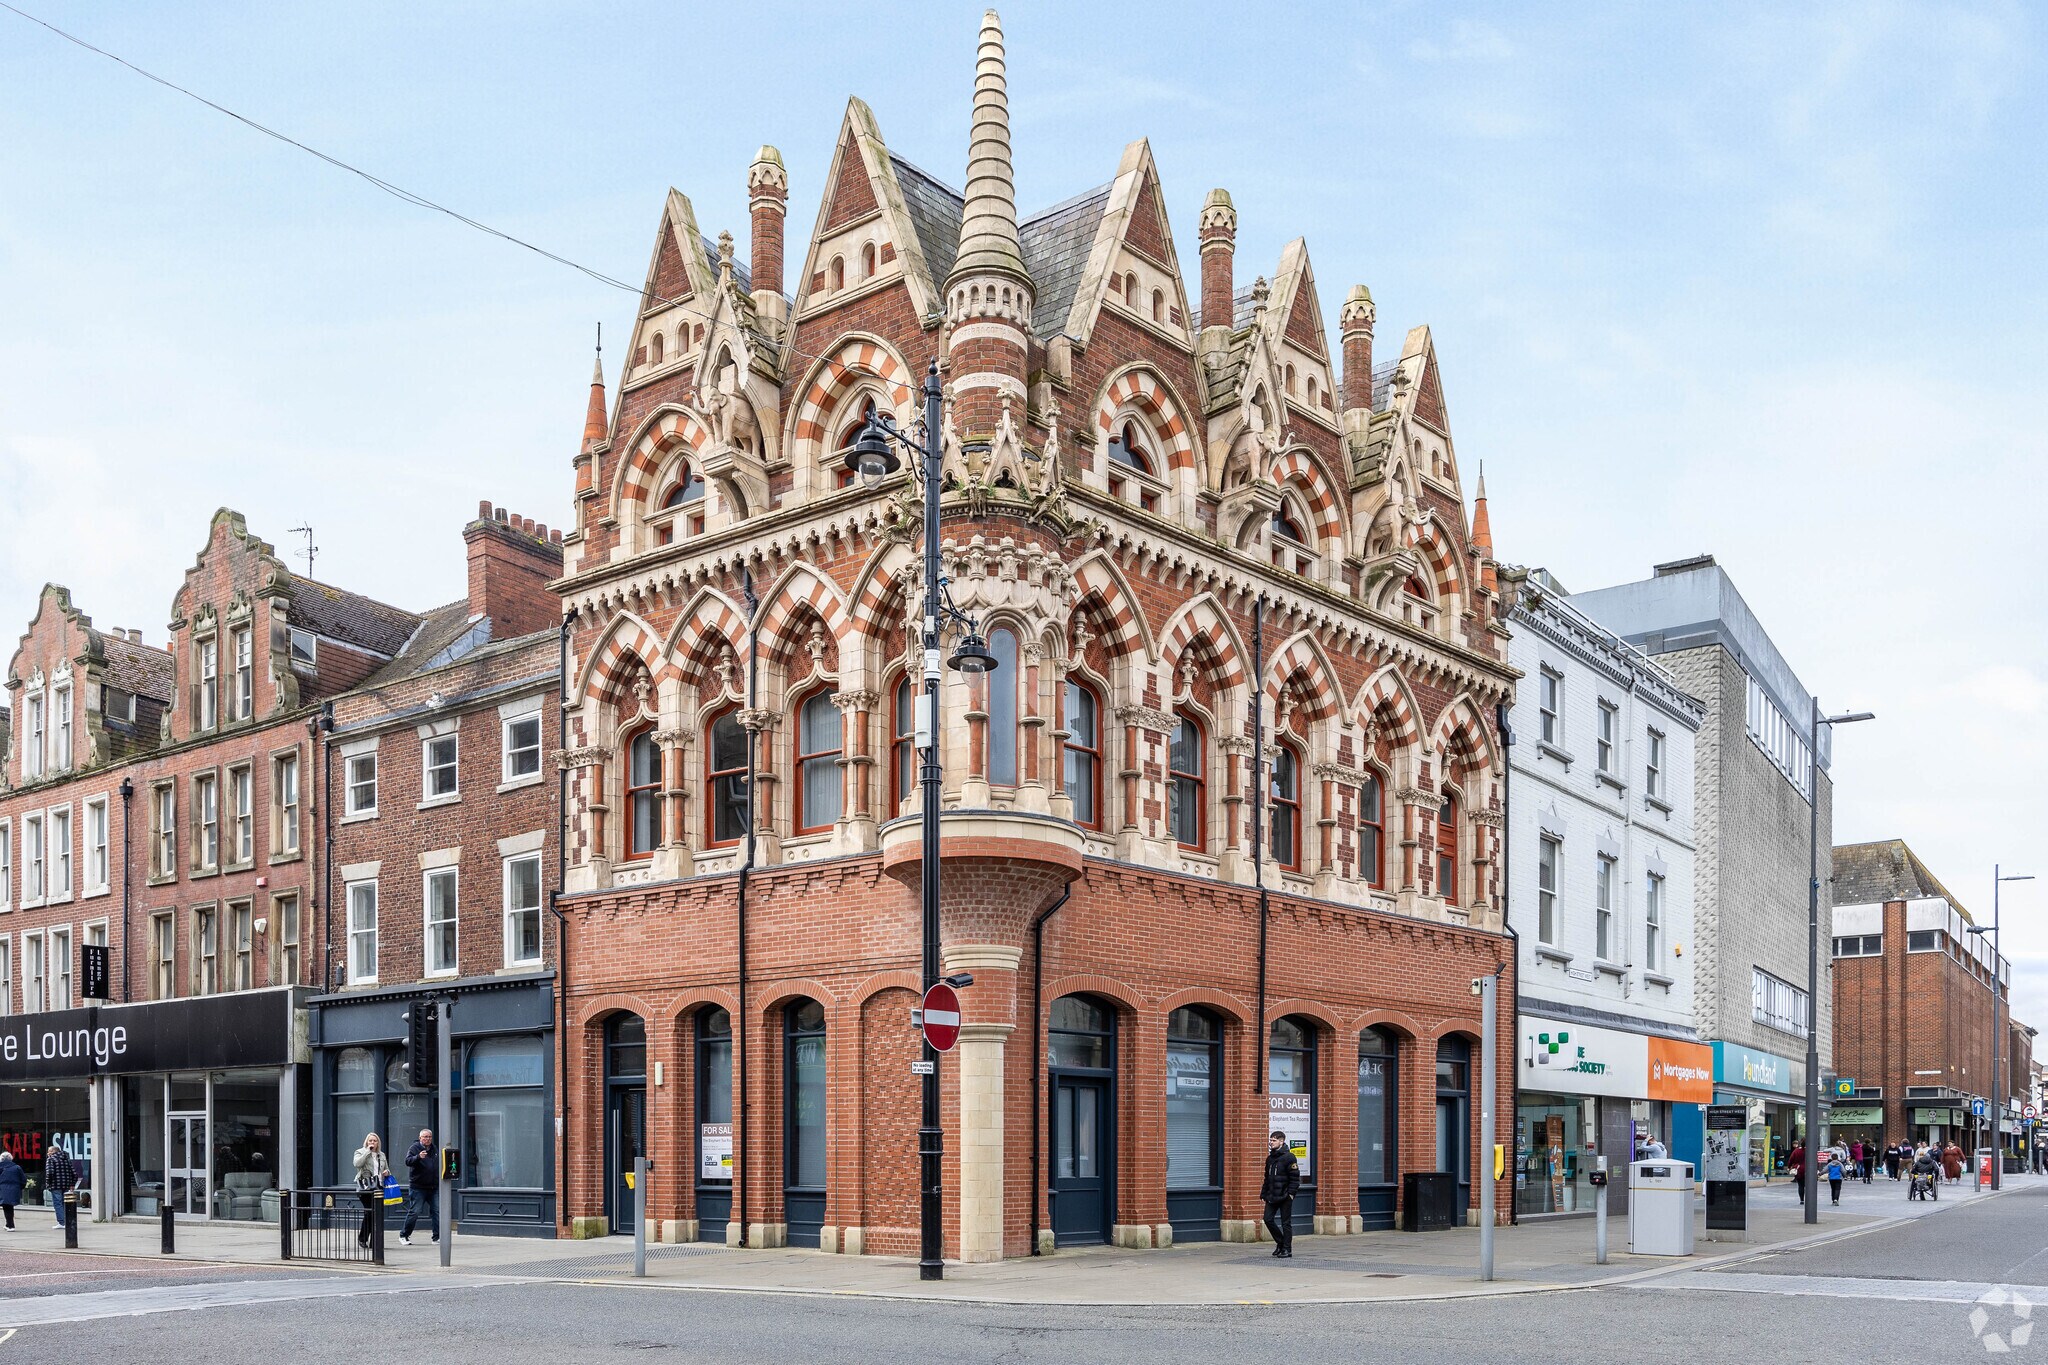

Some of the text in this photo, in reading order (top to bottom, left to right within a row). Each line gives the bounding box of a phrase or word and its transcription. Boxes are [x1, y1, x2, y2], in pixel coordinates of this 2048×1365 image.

[0, 1024, 127, 1066] e Lounge
[1579, 1061, 1605, 1075] SOCIETY
[1663, 1062, 1709, 1081] Mortgages Now
[1743, 1055, 1776, 1085] Poundland
[1286, 1098, 1308, 1109] SALE
[704, 1126, 732, 1134] FOR SAL
[3, 1133, 92, 1160] SALE SALE
